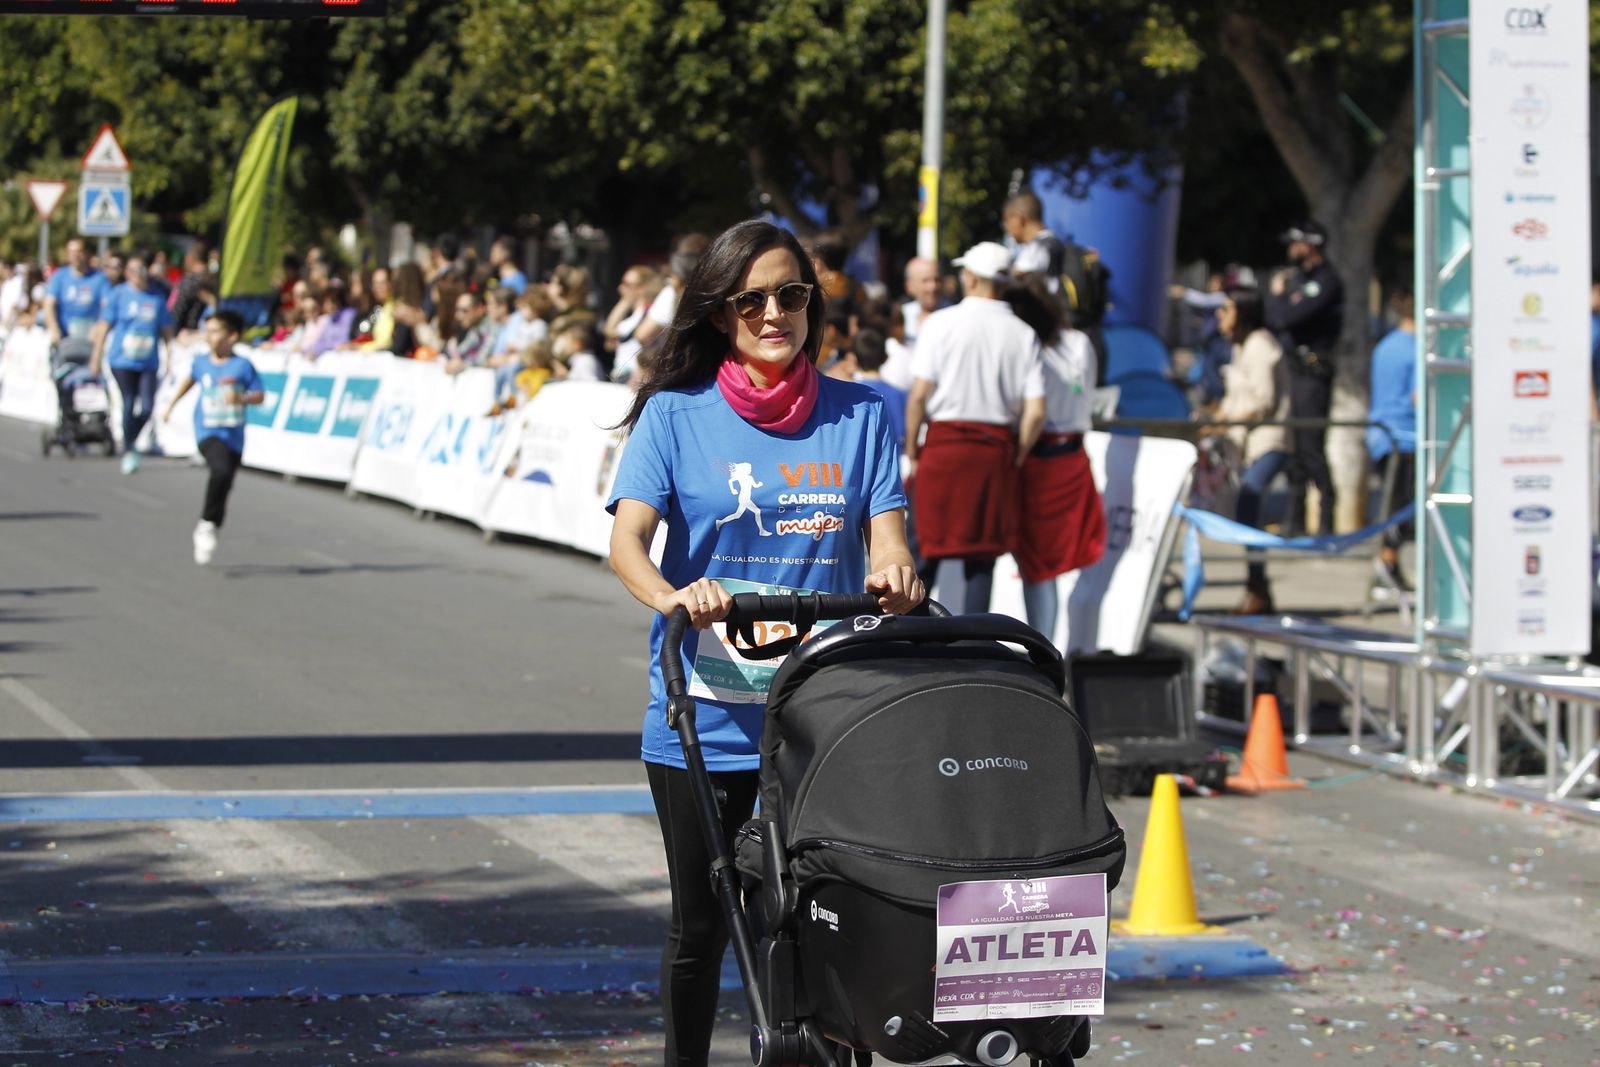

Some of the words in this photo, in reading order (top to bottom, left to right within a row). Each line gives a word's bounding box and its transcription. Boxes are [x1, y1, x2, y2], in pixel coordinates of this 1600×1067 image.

[777, 463, 843, 487] VIII
[778, 494, 846, 505] CARRERA
[776, 511, 844, 541] mujer
[722, 555, 767, 563] IGUALDAD
[782, 557, 820, 565] NUESTRA
[966, 757, 1029, 771] CONCORD
[1021, 882, 1046, 893] VIII
[944, 929, 1097, 964] ATLETA
[960, 992, 976, 1000] CDX
